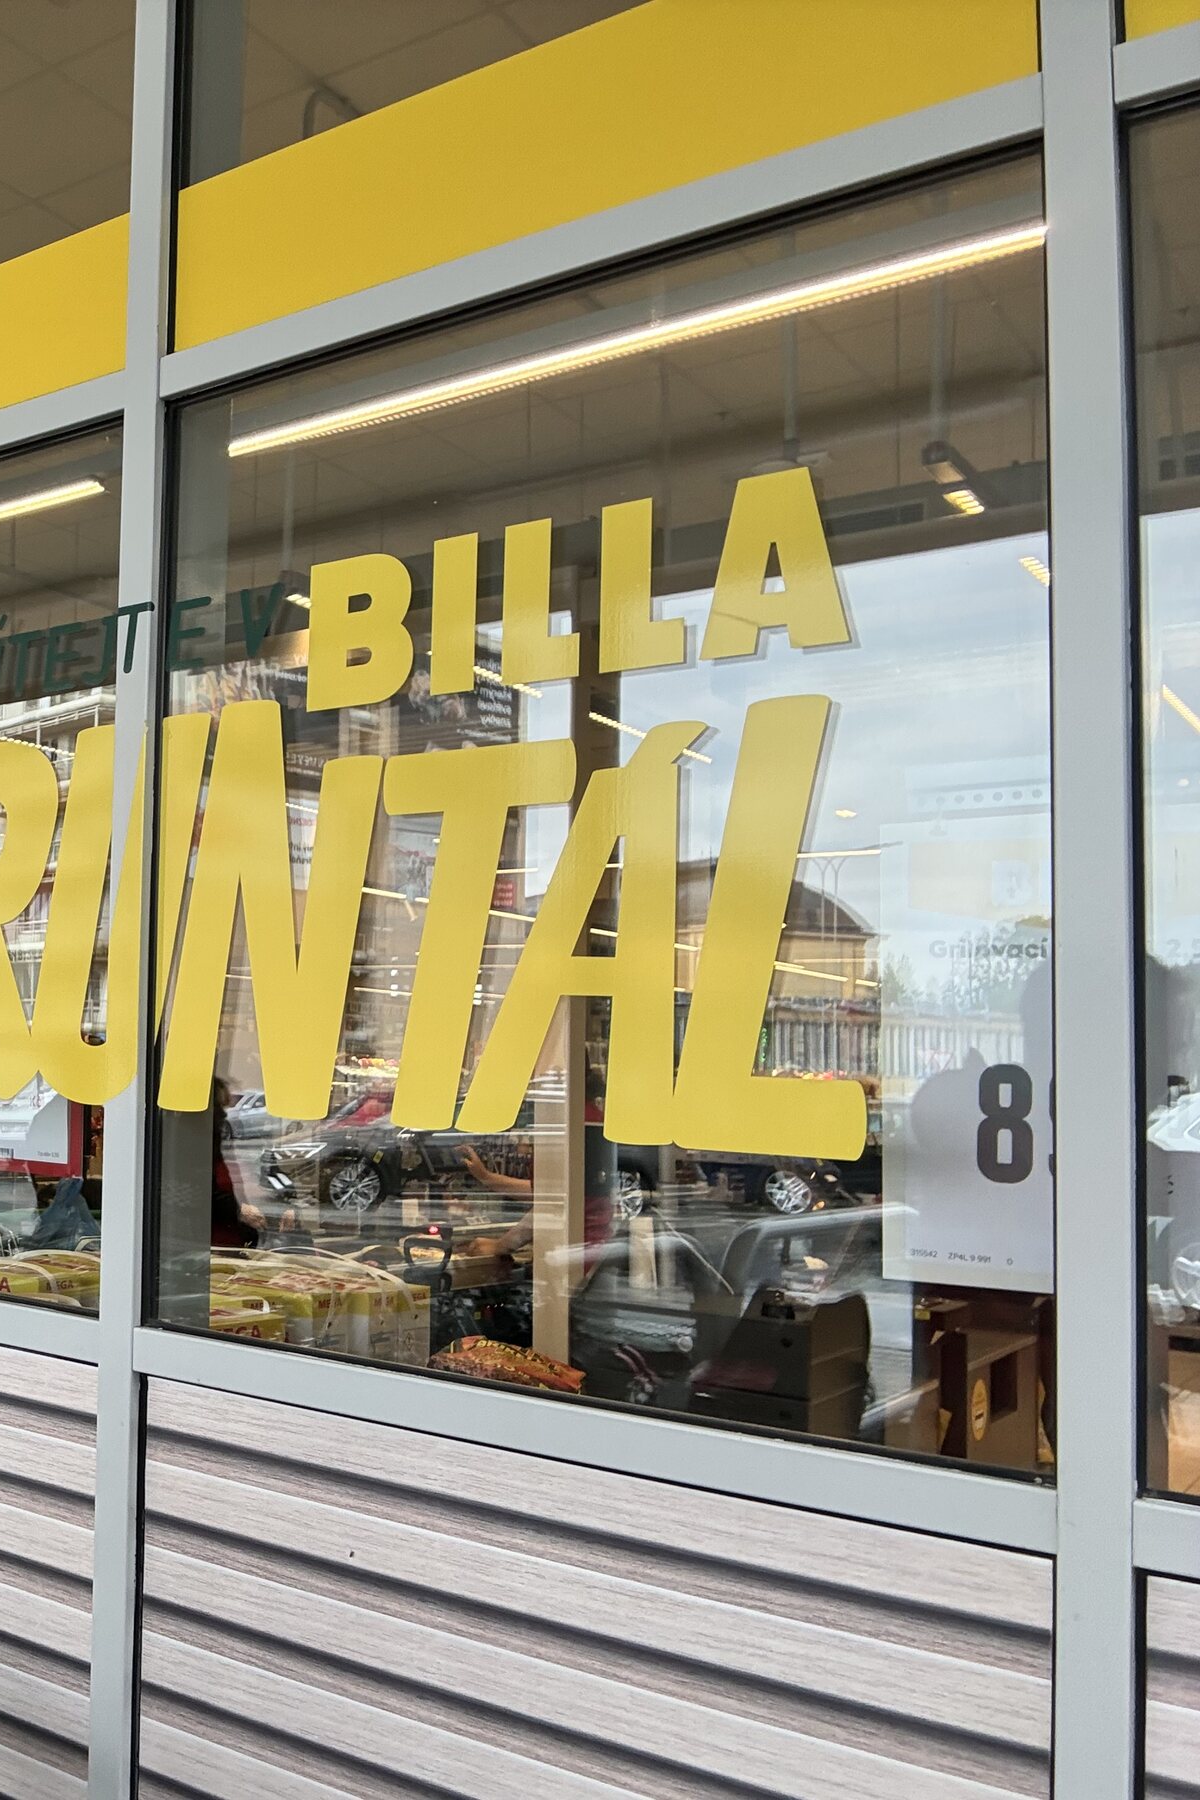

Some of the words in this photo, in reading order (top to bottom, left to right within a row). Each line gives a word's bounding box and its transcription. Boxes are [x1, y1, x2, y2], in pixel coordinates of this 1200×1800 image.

[241, 583, 285, 657] V
[306, 466, 852, 713] BILLA
[976, 1063, 1054, 1185] 8
